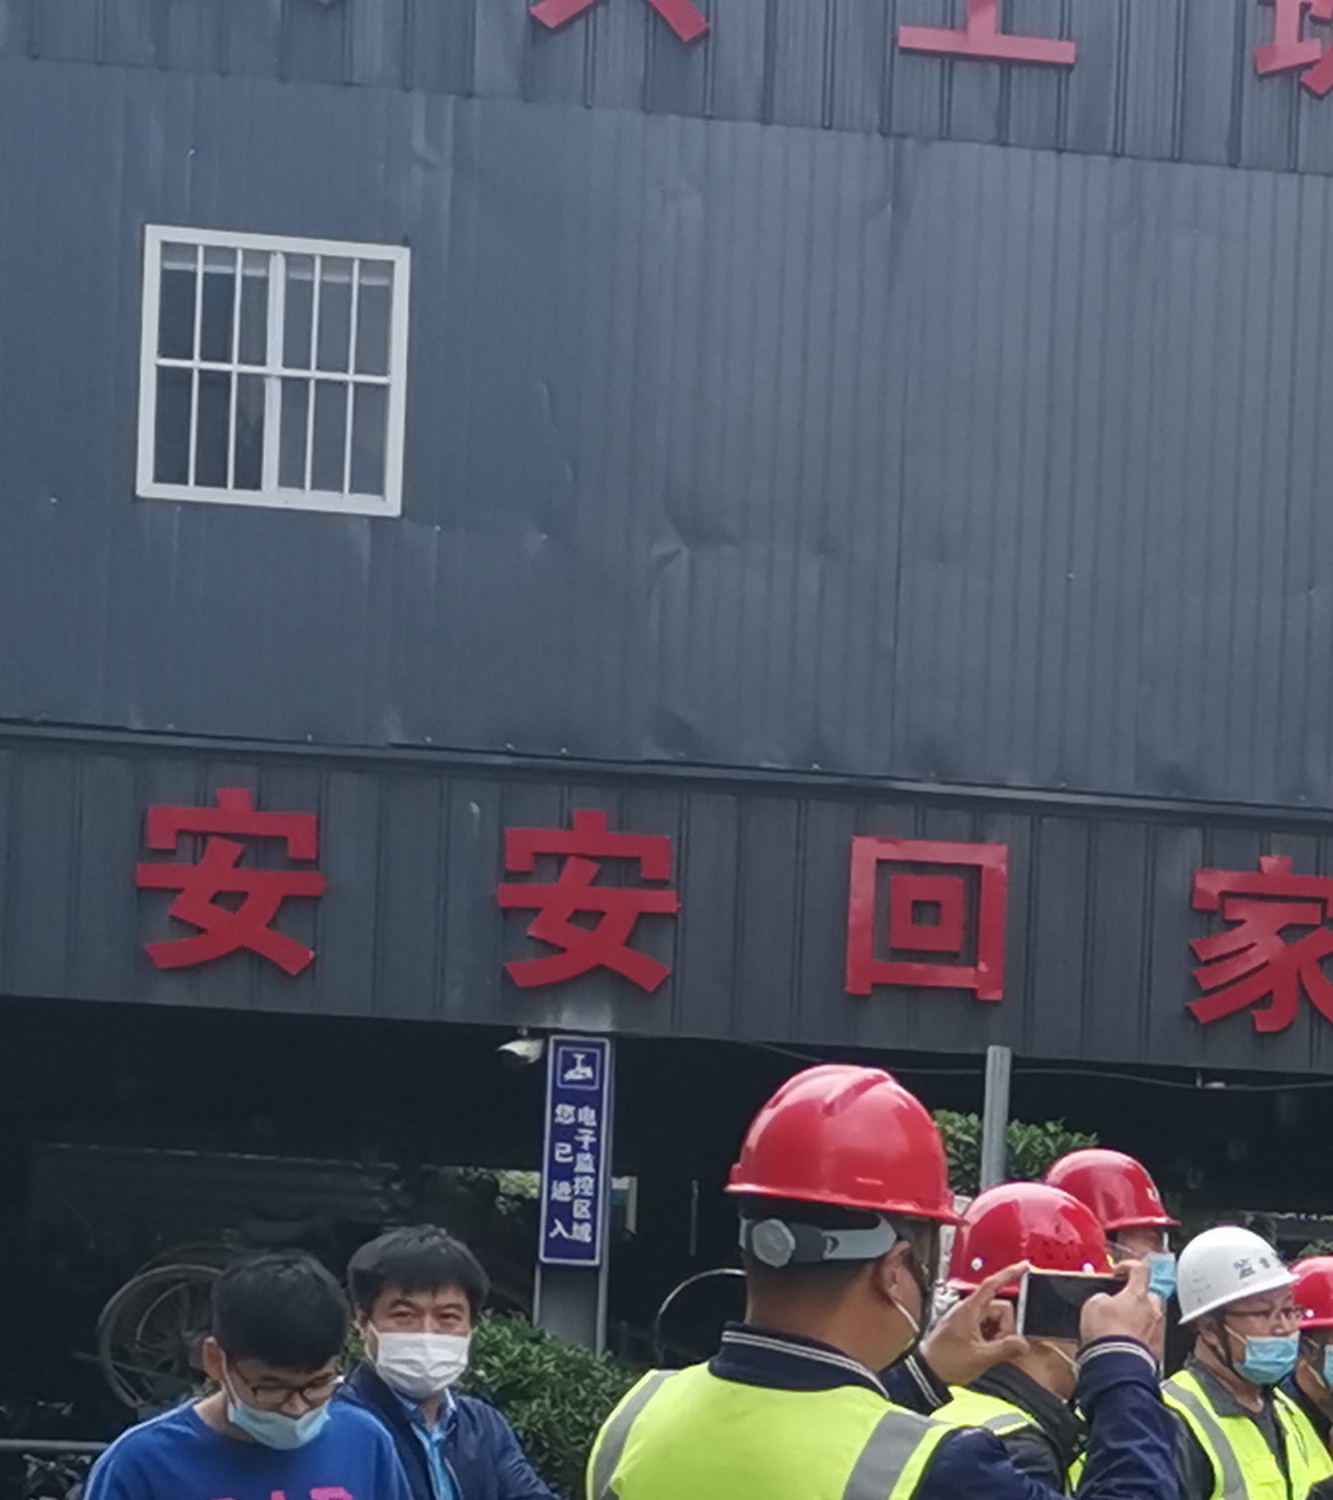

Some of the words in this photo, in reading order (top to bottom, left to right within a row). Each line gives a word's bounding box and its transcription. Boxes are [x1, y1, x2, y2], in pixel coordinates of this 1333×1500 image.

[549, 1103, 575, 1239] 您已进入
[572, 1105, 597, 1243] 电子监控区域
